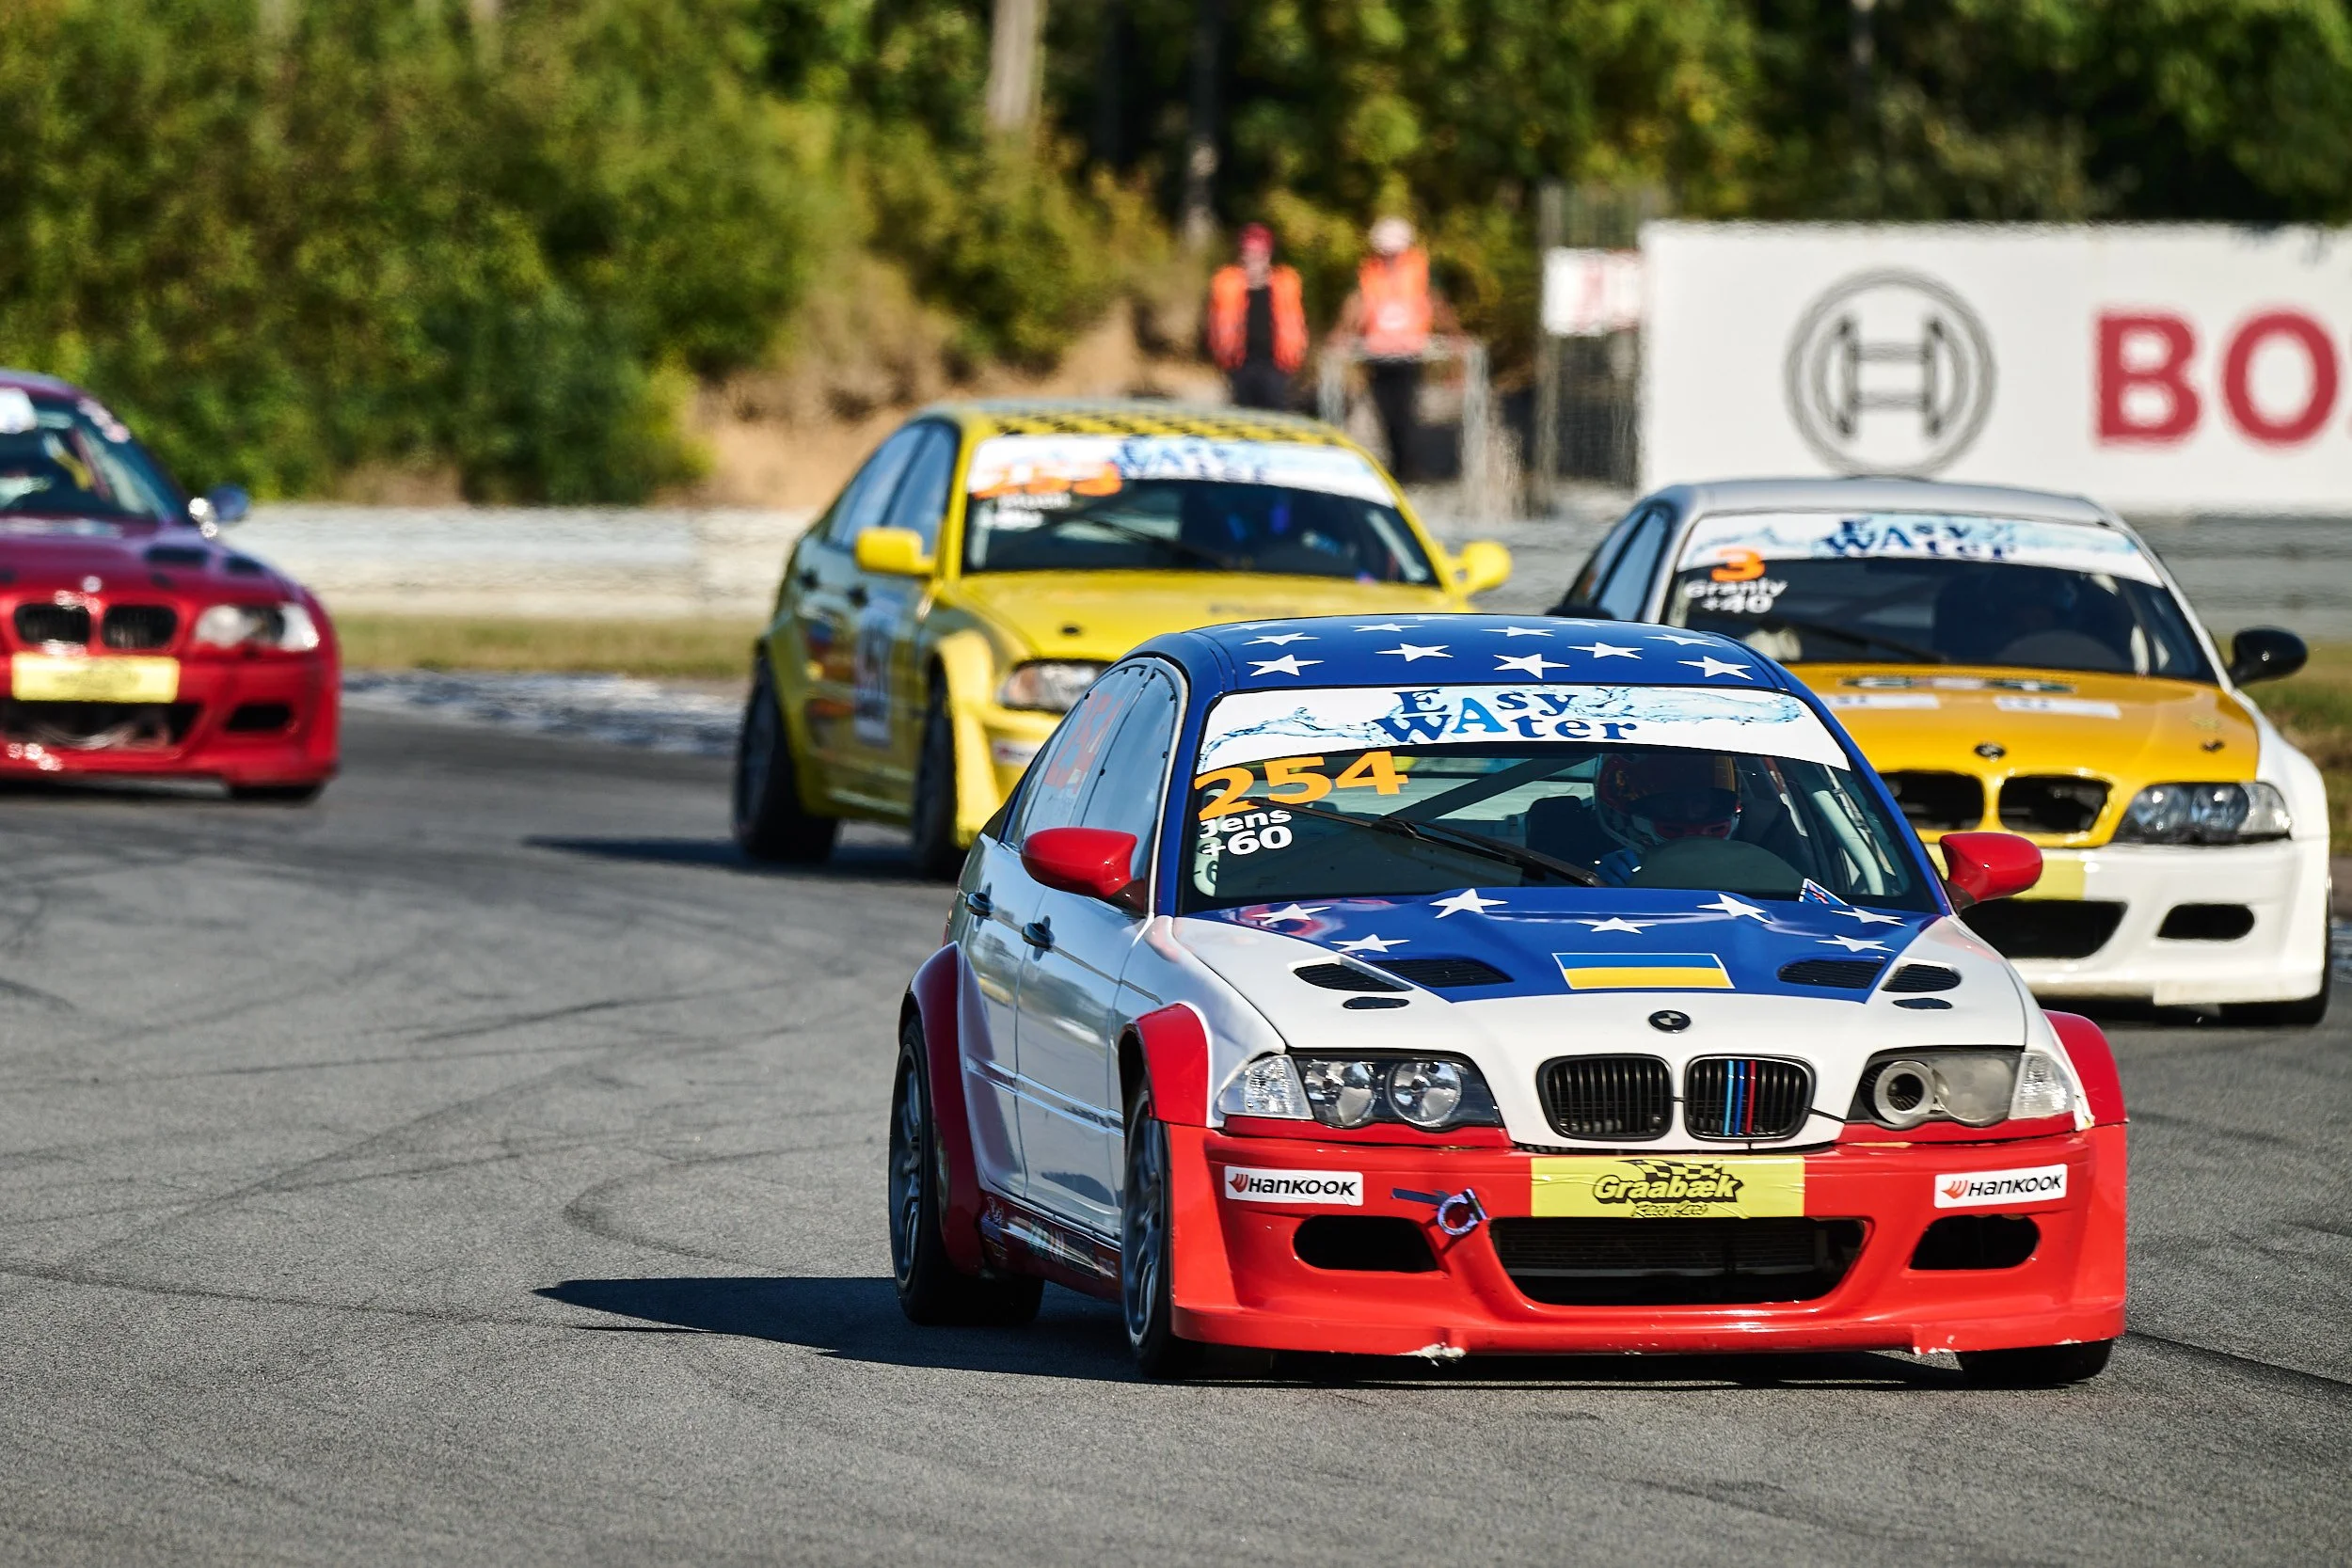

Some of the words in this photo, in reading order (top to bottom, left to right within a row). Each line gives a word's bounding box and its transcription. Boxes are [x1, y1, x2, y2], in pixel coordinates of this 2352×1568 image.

[2094, 309, 2352, 446] BO
[1710, 547, 1767, 582] 3
[1194, 751, 1409, 821] 254
[1200, 809, 1293, 838] Jens
[1201, 825, 1294, 856] +60
[1593, 1173, 1741, 1204] Graabæk
